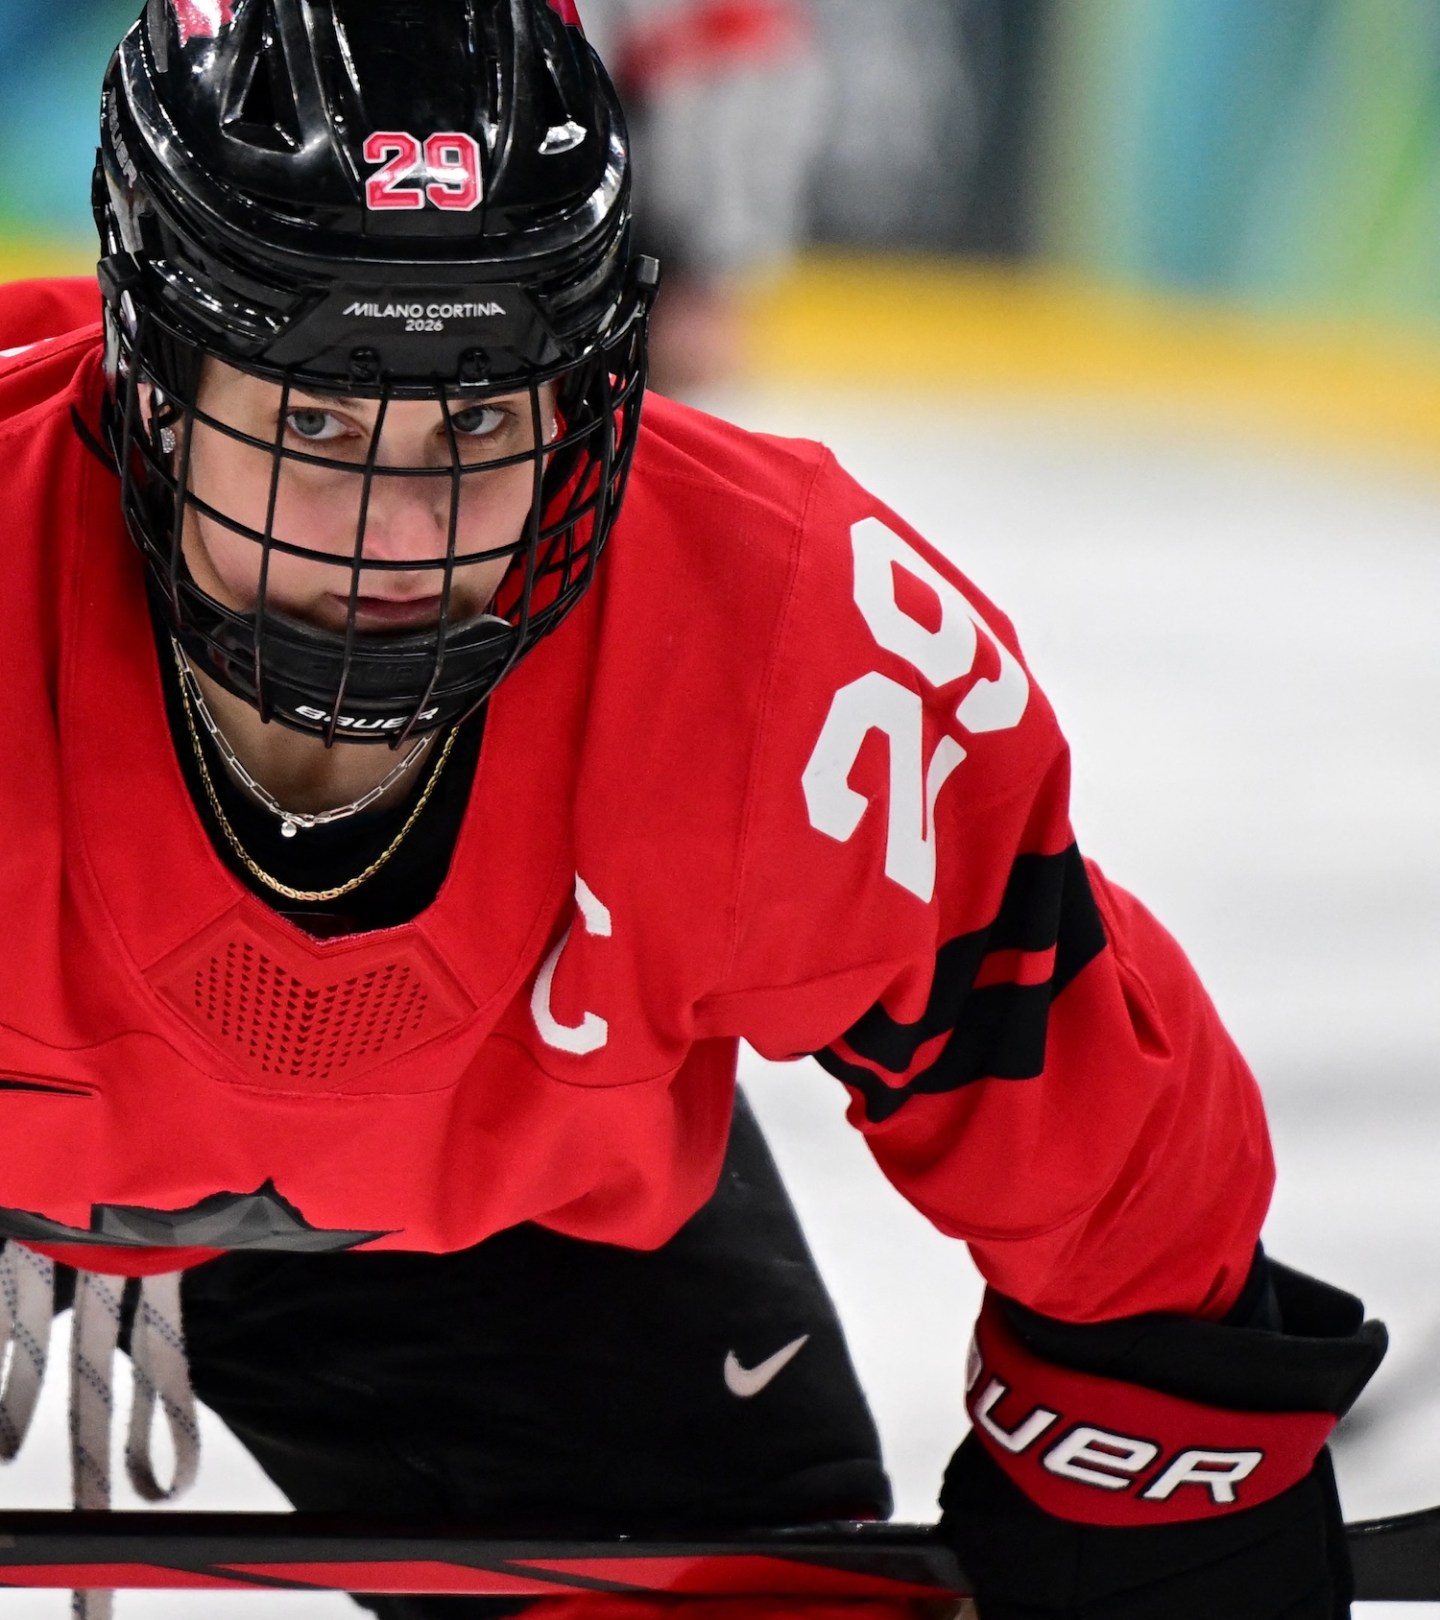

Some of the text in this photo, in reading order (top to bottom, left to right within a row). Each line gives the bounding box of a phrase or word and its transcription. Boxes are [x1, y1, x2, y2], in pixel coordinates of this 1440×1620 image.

[363, 131, 482, 210] 29
[342, 302, 506, 318] MILANO CORTINA
[405, 319, 444, 331] 2026
[801, 516, 1029, 904] 29
[530, 870, 612, 1055] C
[966, 1338, 1262, 1504] UER
